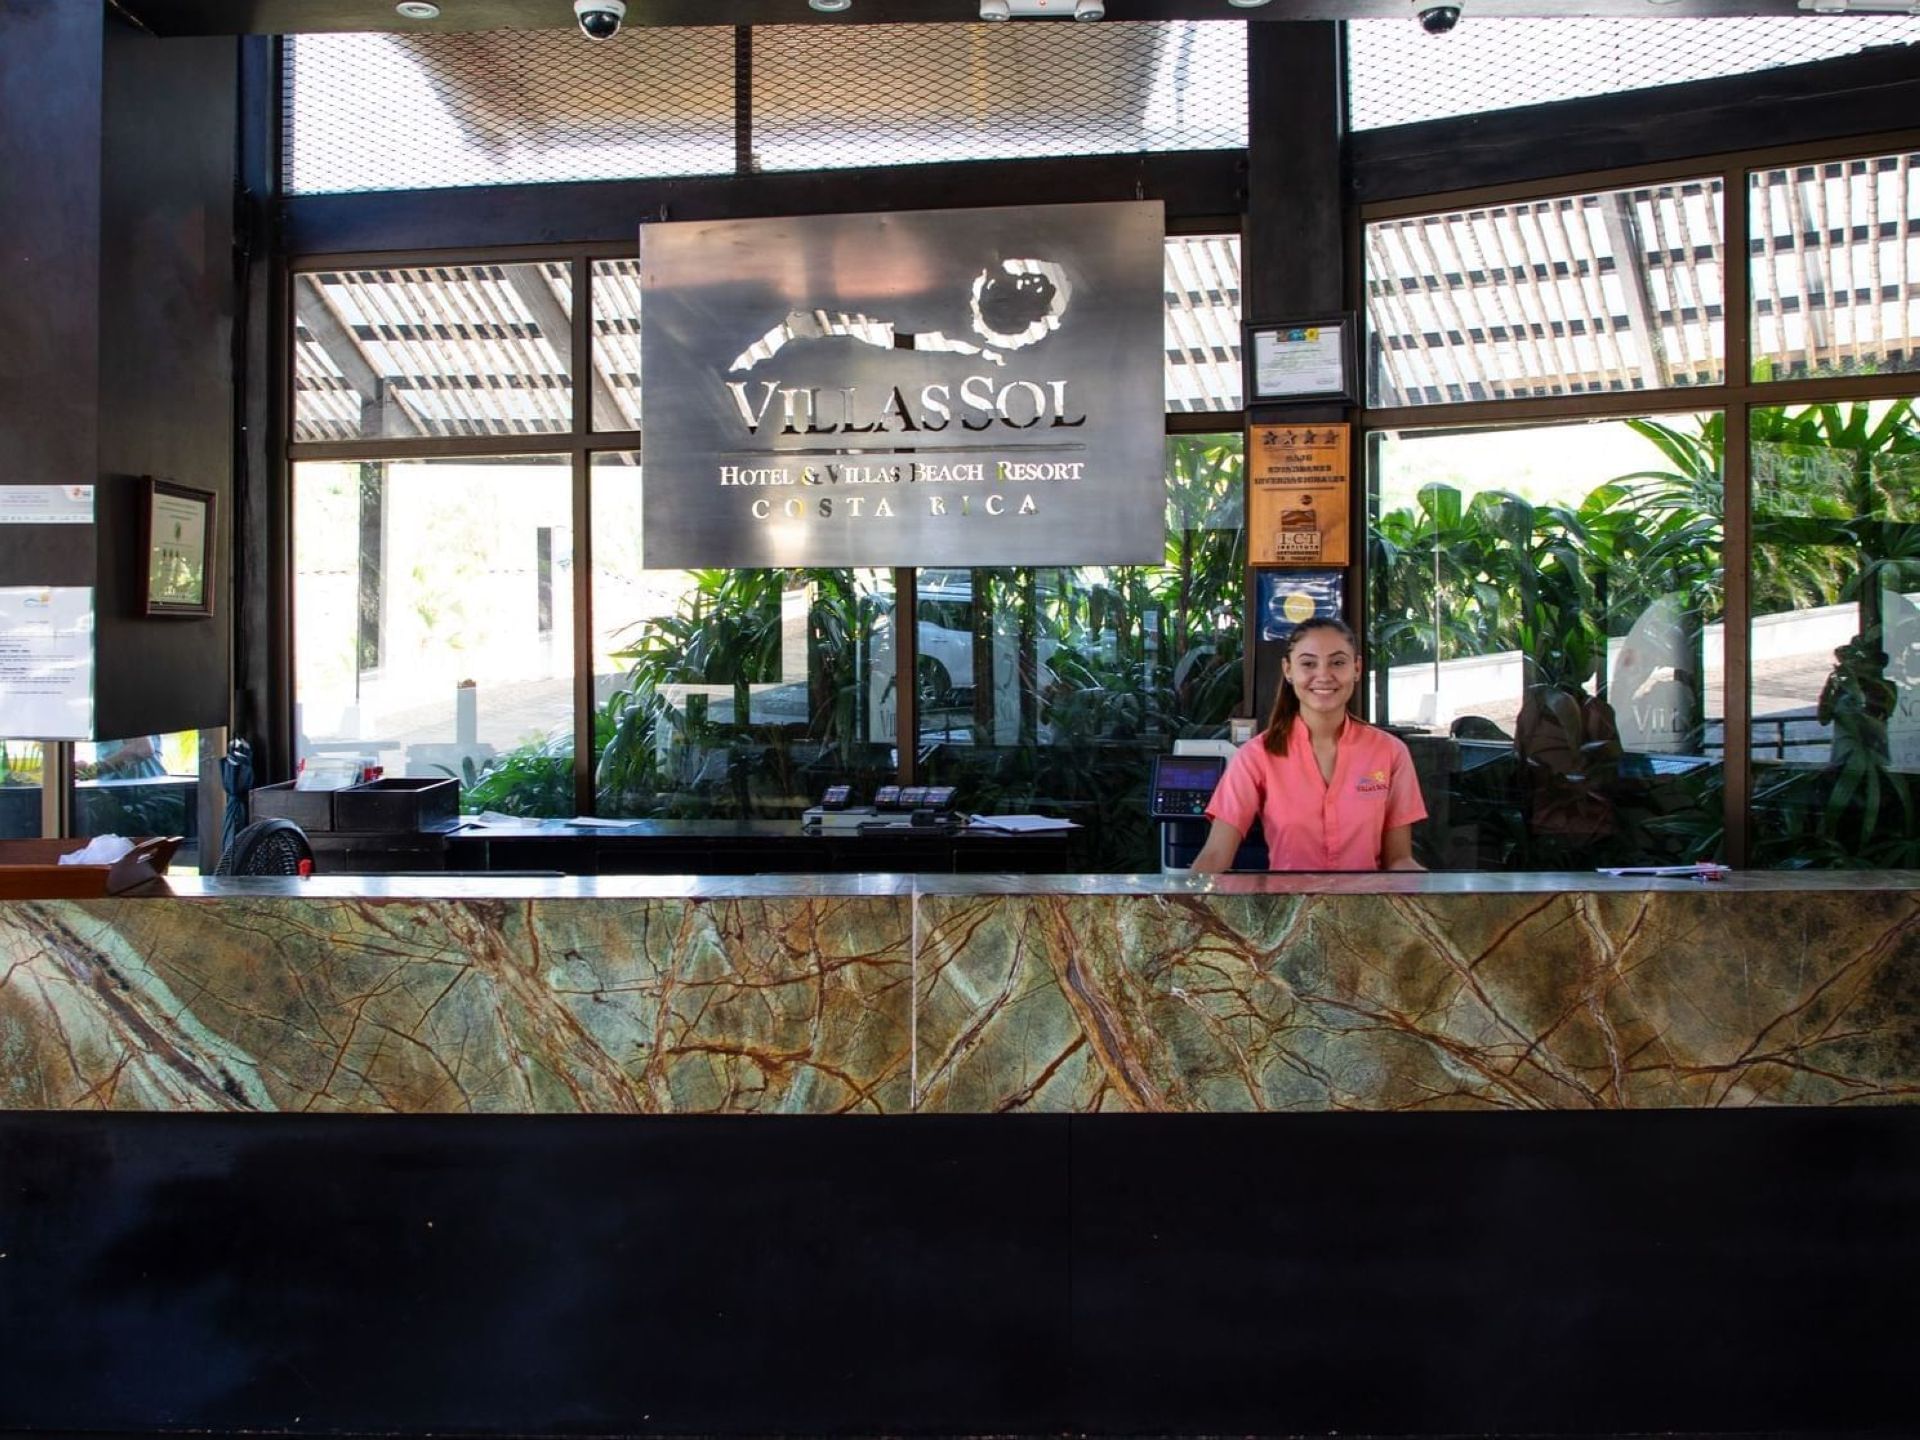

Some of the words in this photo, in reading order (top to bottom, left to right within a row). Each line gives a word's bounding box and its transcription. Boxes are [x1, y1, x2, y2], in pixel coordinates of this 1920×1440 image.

[720, 466, 794, 486] HOTEL
[800, 465, 823, 485] &
[824, 464, 901, 484] VILLAS
[909, 463, 984, 483] BEACH
[997, 461, 1085, 481] RESORT
[752, 498, 894, 518] COSTA
[930, 494, 1040, 517] RICA
